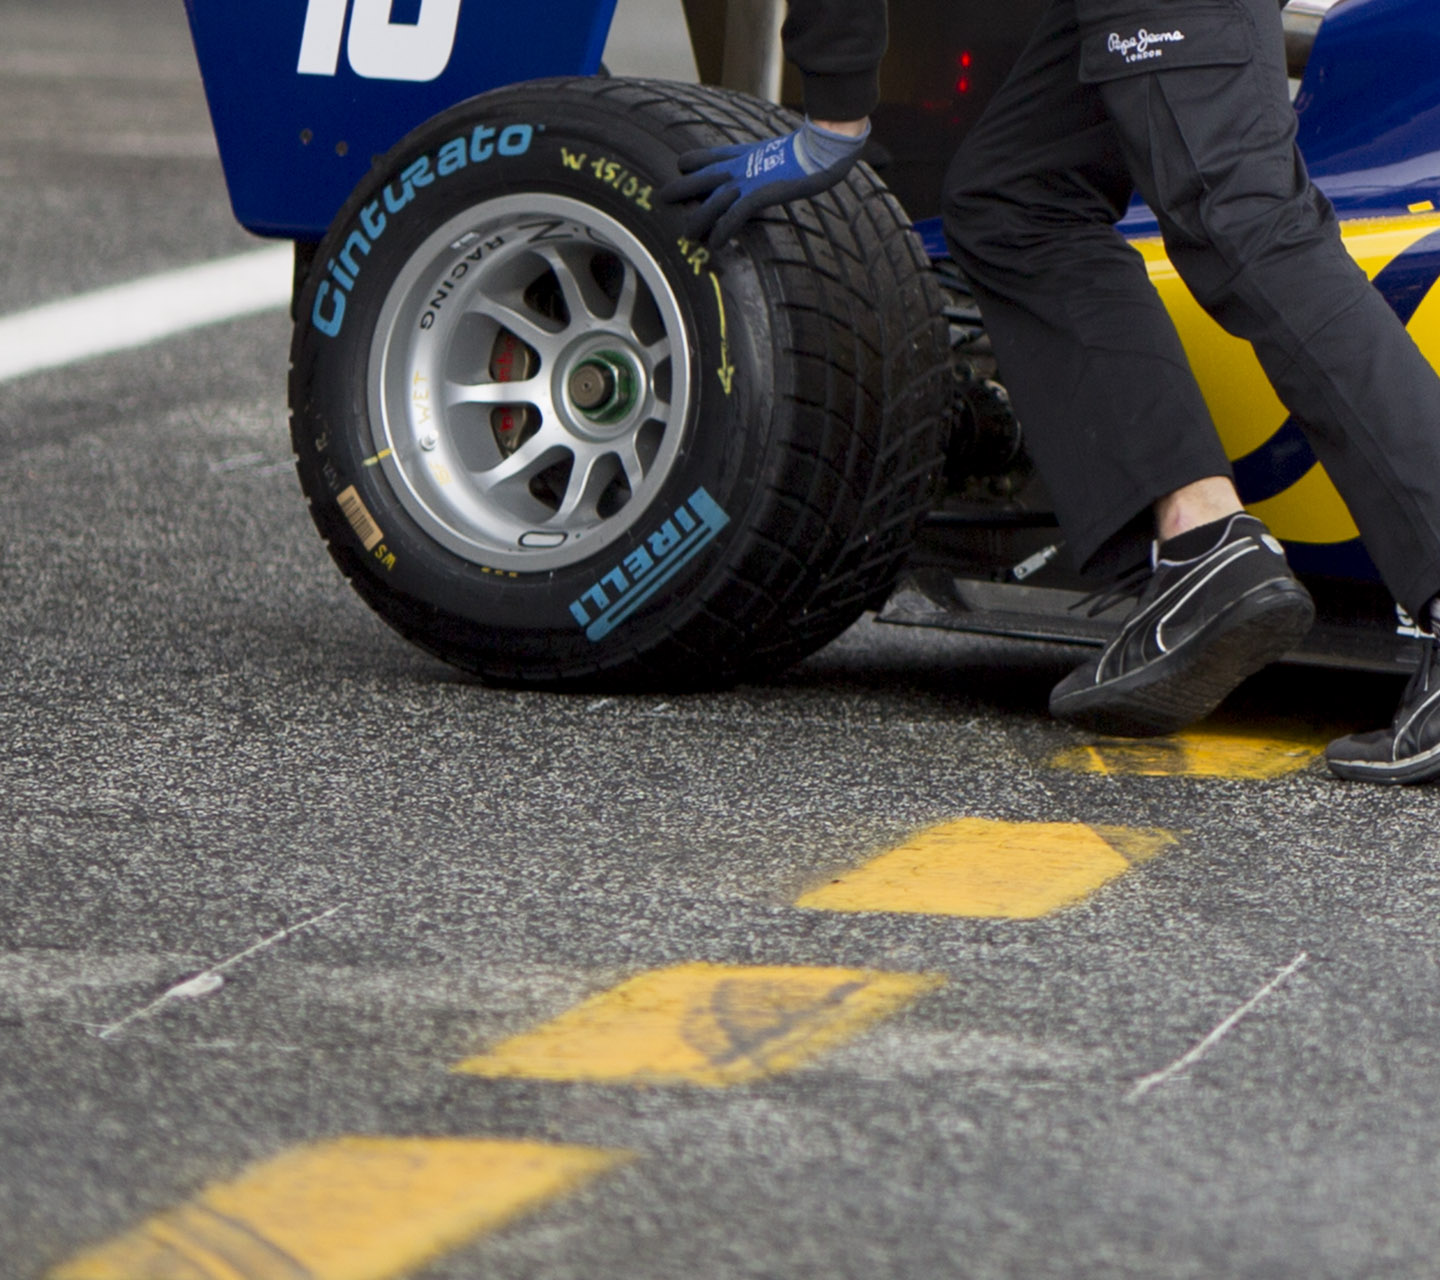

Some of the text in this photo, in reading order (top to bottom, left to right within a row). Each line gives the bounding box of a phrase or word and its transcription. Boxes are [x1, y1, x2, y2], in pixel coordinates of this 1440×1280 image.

[1107, 28, 1184, 54] Pepe Jeans
[1125, 49, 1162, 63] LONDON
[420, 236, 505, 332] RACING
[374, 544, 398, 572] WS
[568, 486, 730, 644] PIRELLI
